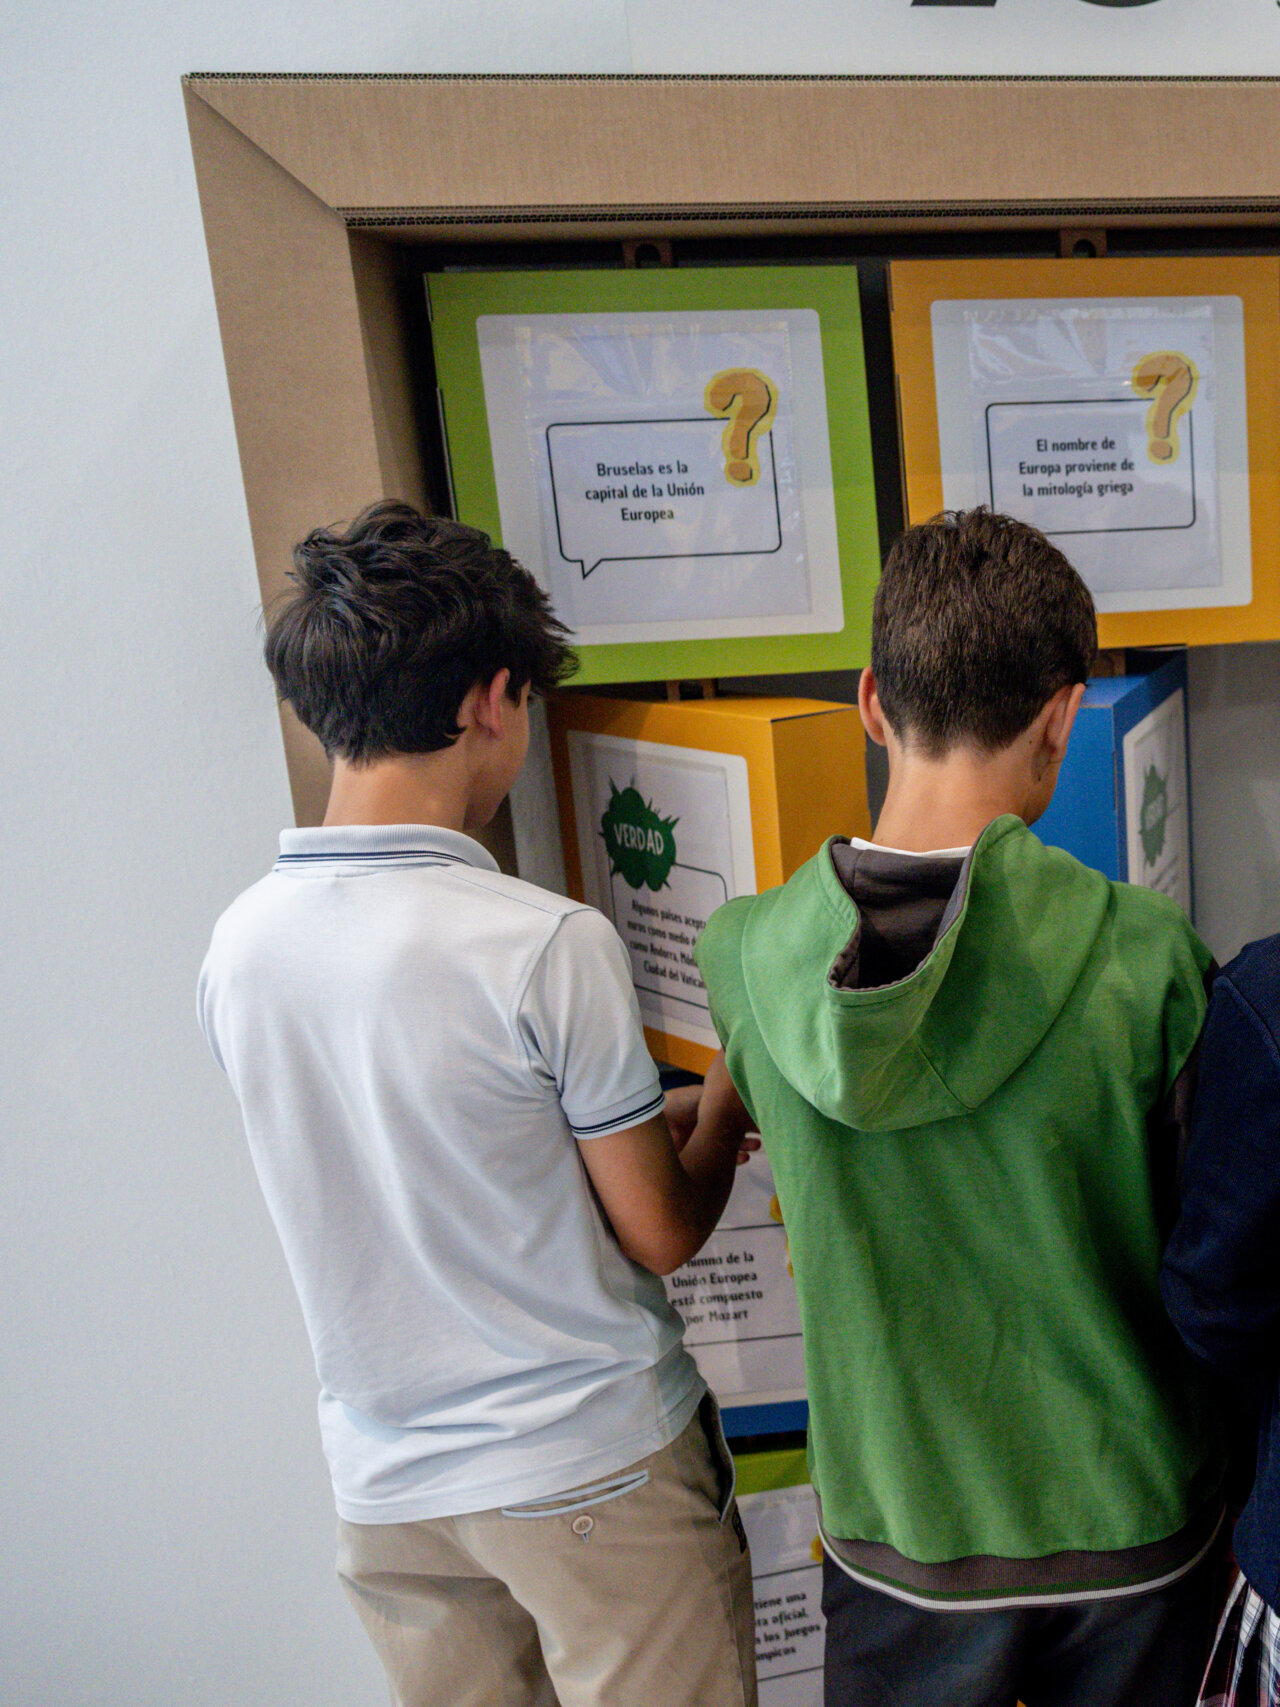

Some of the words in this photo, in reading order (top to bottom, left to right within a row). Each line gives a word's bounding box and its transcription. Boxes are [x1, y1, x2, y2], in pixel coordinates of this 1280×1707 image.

[1036, 438, 1048, 452] El
[1052, 438, 1098, 451] nombre
[1101, 436, 1116, 450] de
[597, 461, 654, 477] Bruselas
[658, 463, 672, 475] es
[676, 460, 688, 474] la
[1019, 461, 1061, 477] Europa
[1065, 460, 1117, 476] proviene
[1121, 458, 1135, 471] de
[585, 484, 629, 503] capital
[632, 484, 648, 499] de
[652, 484, 663, 498] la
[667, 482, 705, 497] Unión
[1022, 483, 1034, 497] la
[1037, 482, 1093, 498] mitología
[1097, 481, 1134, 496] griega
[621, 507, 675, 523] Europea
[613, 822, 665, 856] VERDAD
[726, 1252, 740, 1264] de
[743, 1250, 754, 1263] la
[672, 1274, 707, 1288] Unión
[710, 1272, 758, 1286] Europea
[671, 1293, 695, 1307] está
[700, 1290, 763, 1306] compuesto
[685, 1314, 704, 1327] por
[709, 1309, 748, 1322] Mozart
[786, 1593, 807, 1603] una
[764, 1632, 780, 1642] los
